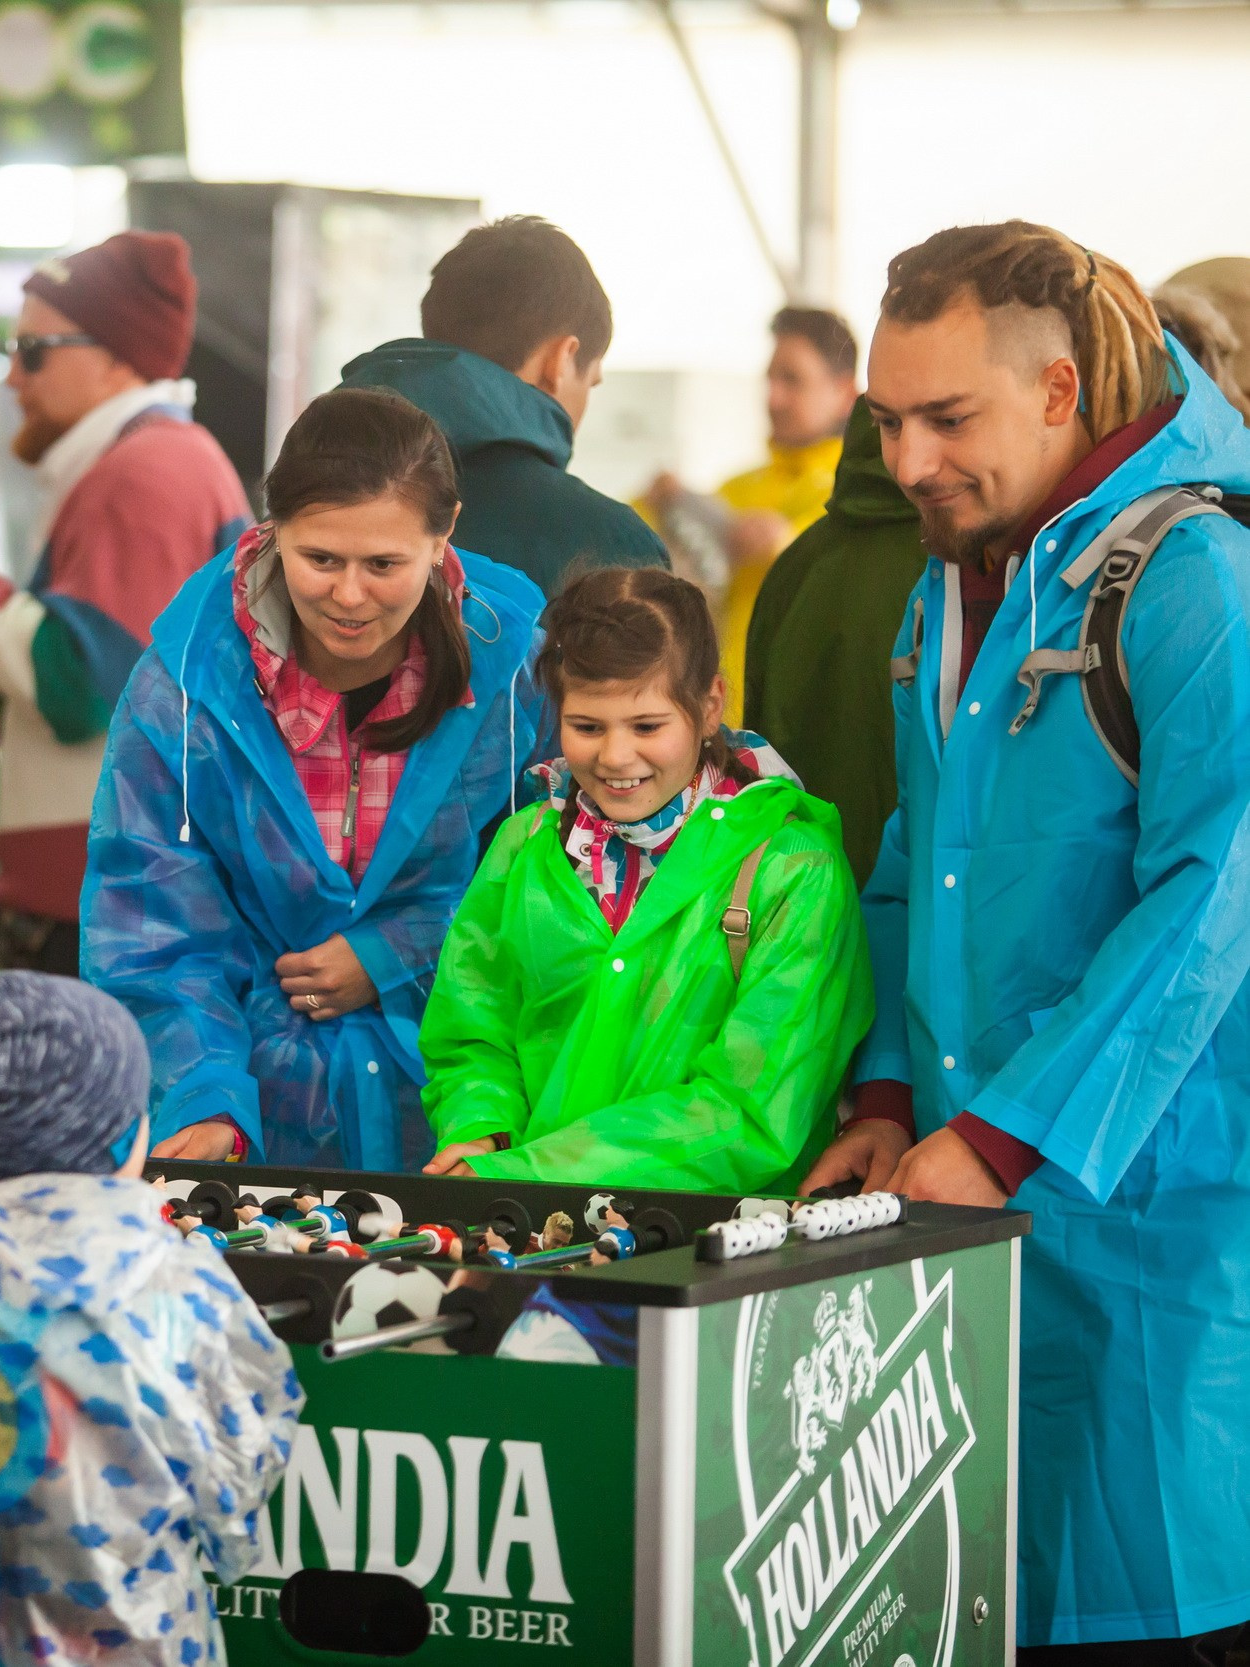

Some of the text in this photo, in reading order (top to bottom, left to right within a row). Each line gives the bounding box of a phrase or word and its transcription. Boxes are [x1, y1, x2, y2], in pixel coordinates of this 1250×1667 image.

[756, 1348, 948, 1667] HOLLANDIA
[467, 1606, 573, 1647] BEER
[842, 1583, 891, 1660] PREMIUM
[849, 1592, 907, 1667] ALITY BEER
